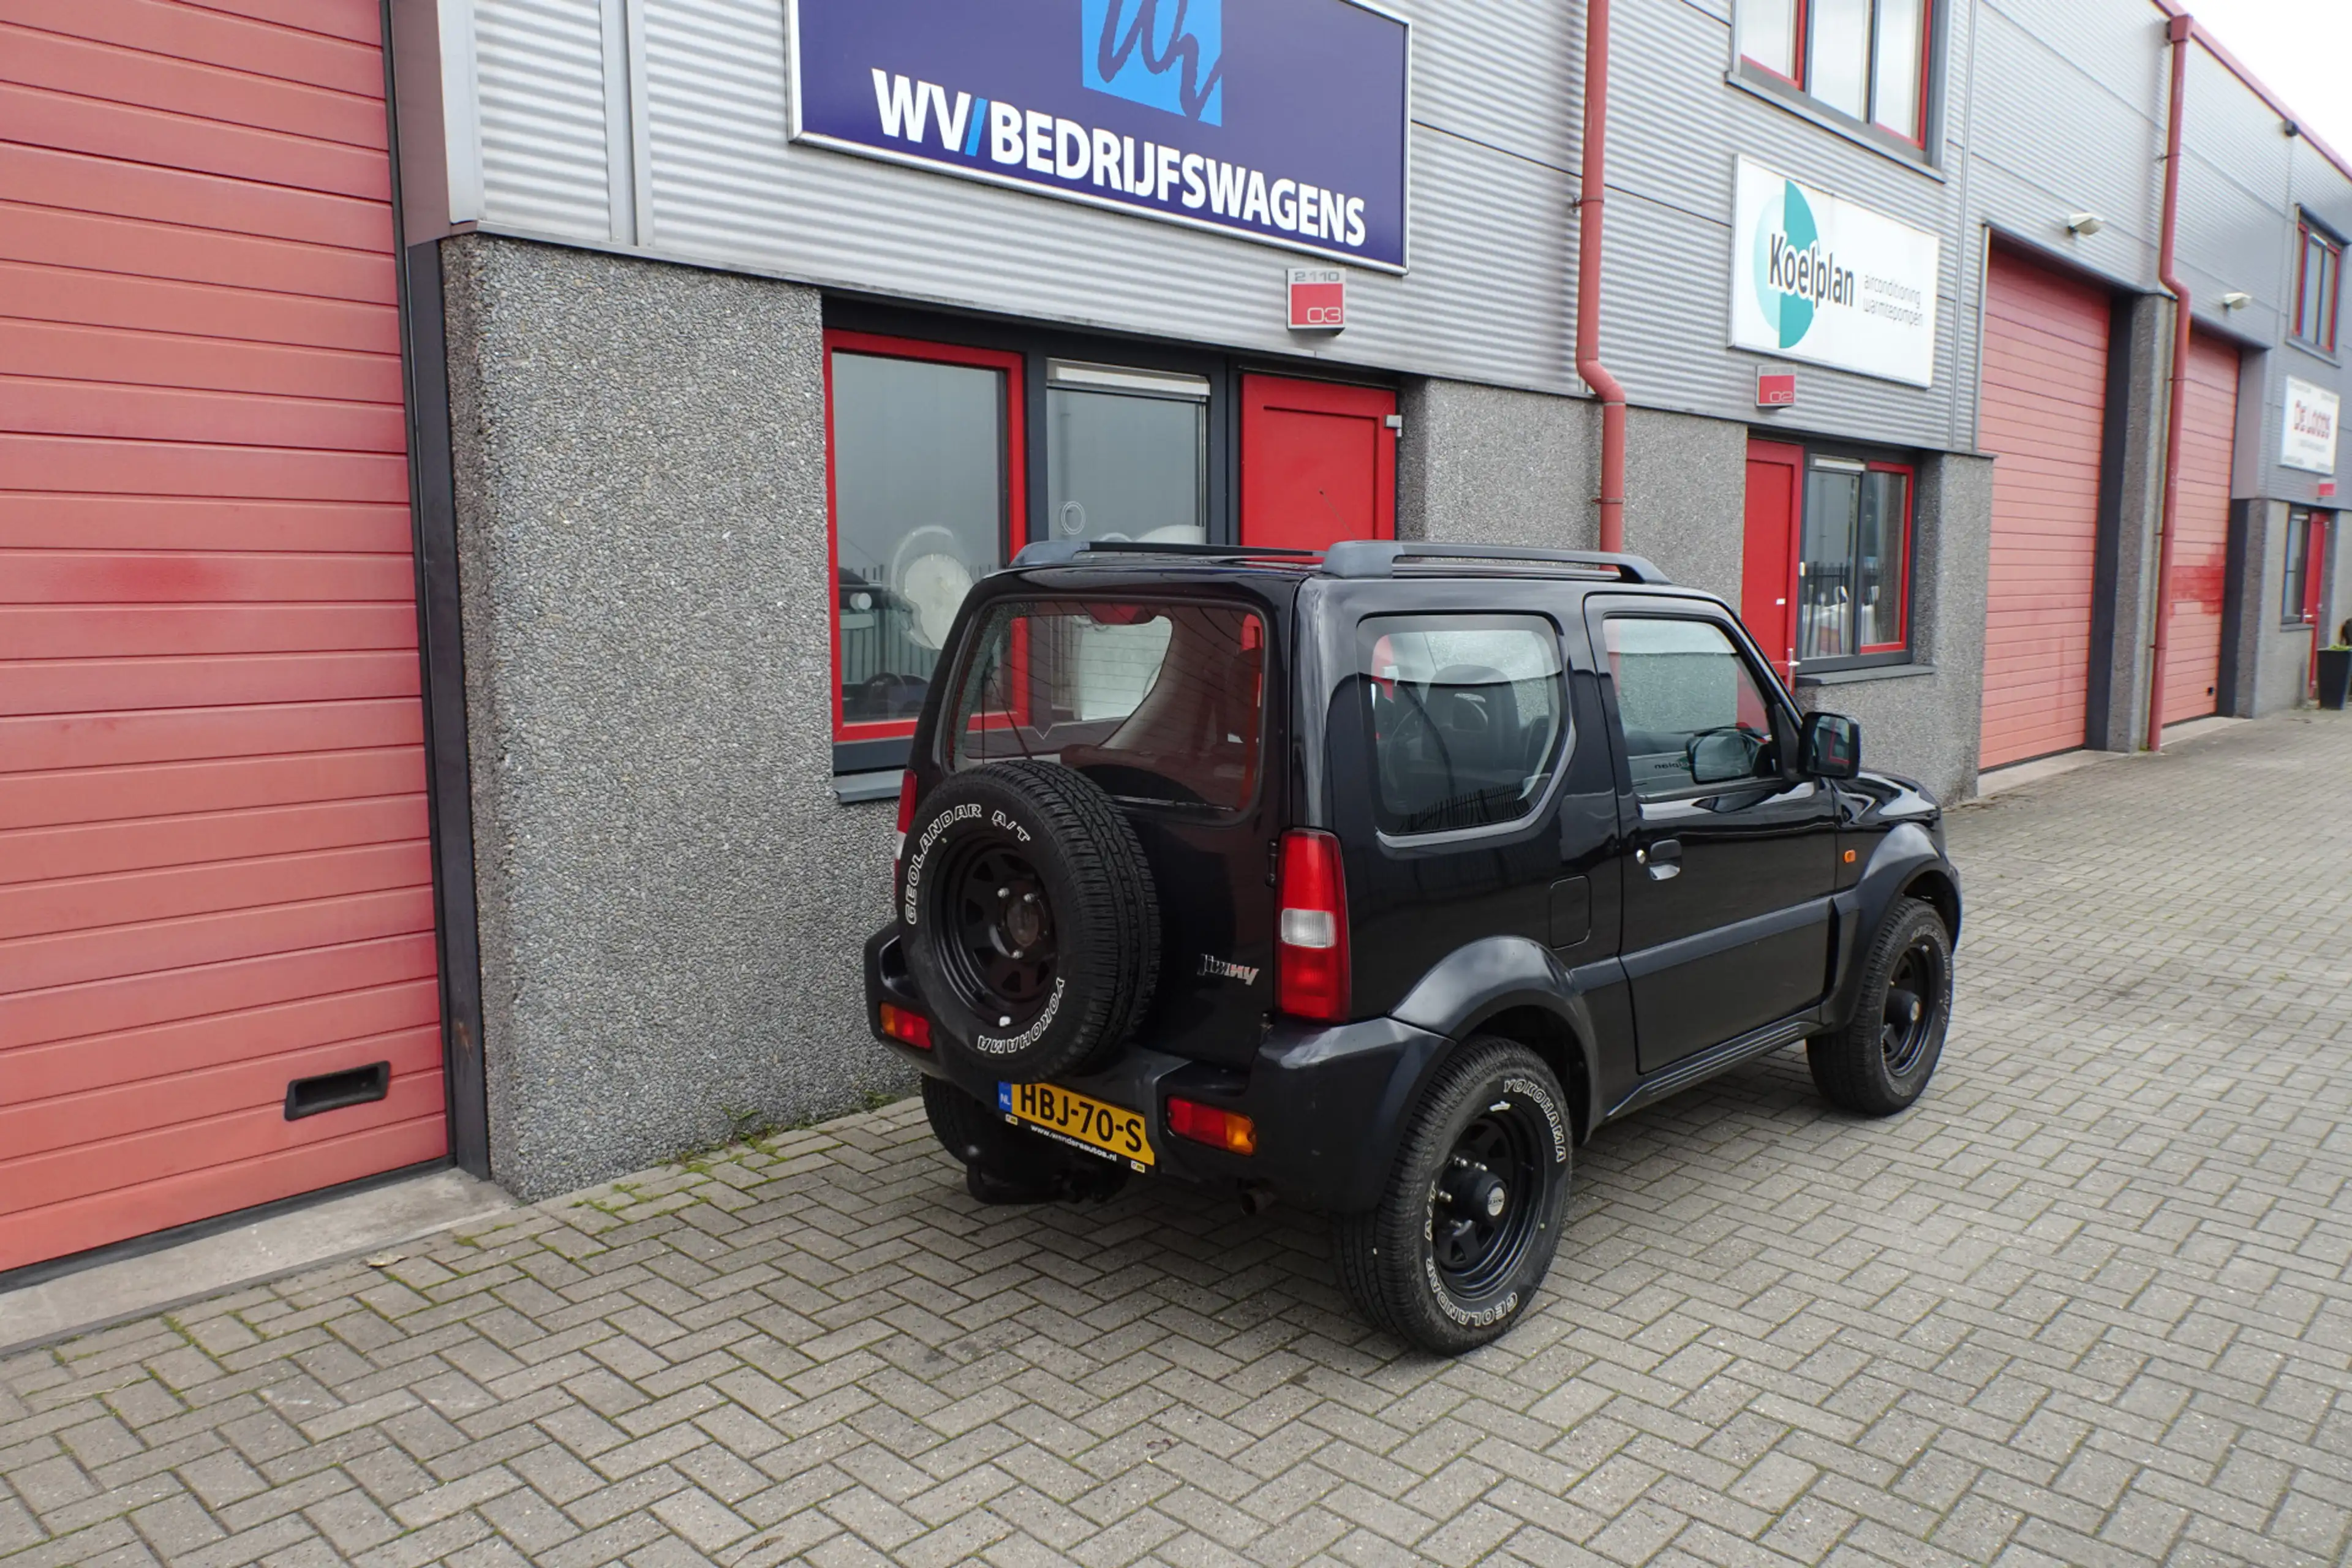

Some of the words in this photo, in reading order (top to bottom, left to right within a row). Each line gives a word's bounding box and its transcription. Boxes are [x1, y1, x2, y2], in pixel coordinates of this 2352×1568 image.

[1294, 271, 1340, 282] 2110
[1769, 233, 1854, 309] Koelplan
[1864, 271, 1921, 309] airconditioning
[1307, 307, 1341, 323] 03
[1770, 391, 1793, 403] 02
[905, 804, 982, 925] GEOLANDAR
[991, 810, 1031, 842] A/T
[977, 976, 1066, 1055] YOKOHAMA
[1000, 1093, 1011, 1106] NL
[1020, 1084, 1142, 1153] HBJ-70-S
[1504, 1079, 1568, 1163] YOKOHAMA
[1425, 1256, 1518, 1327] GEOLANDAR
